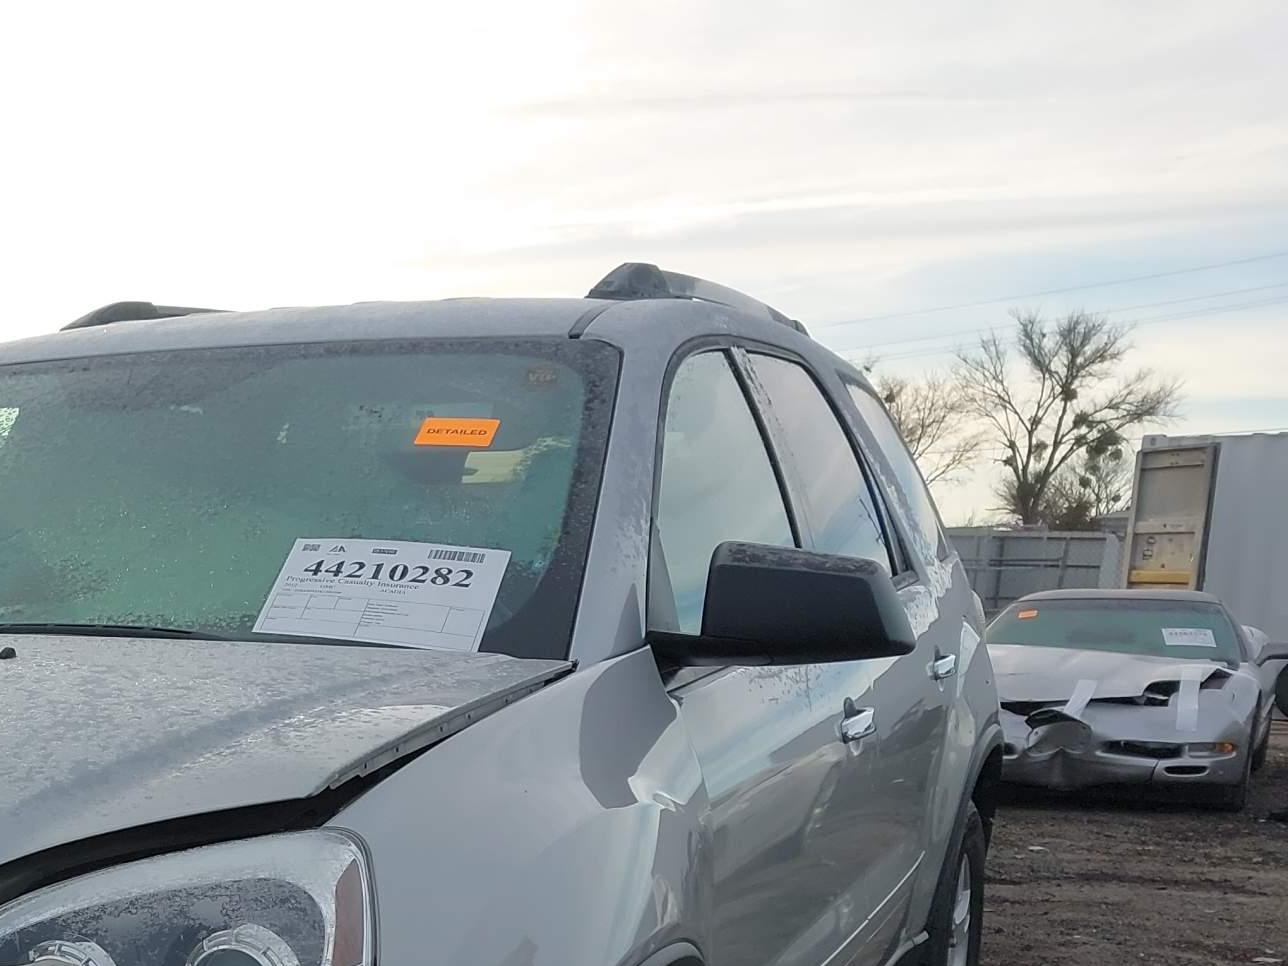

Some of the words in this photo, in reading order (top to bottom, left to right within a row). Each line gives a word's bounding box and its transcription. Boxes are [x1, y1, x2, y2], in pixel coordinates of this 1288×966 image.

[426, 428, 488, 436] DETAILED
[303, 559, 474, 588] 44210282
[286, 575, 336, 584] Progressive
[338, 579, 374, 587] Casualty
[377, 581, 420, 591] Insurance
